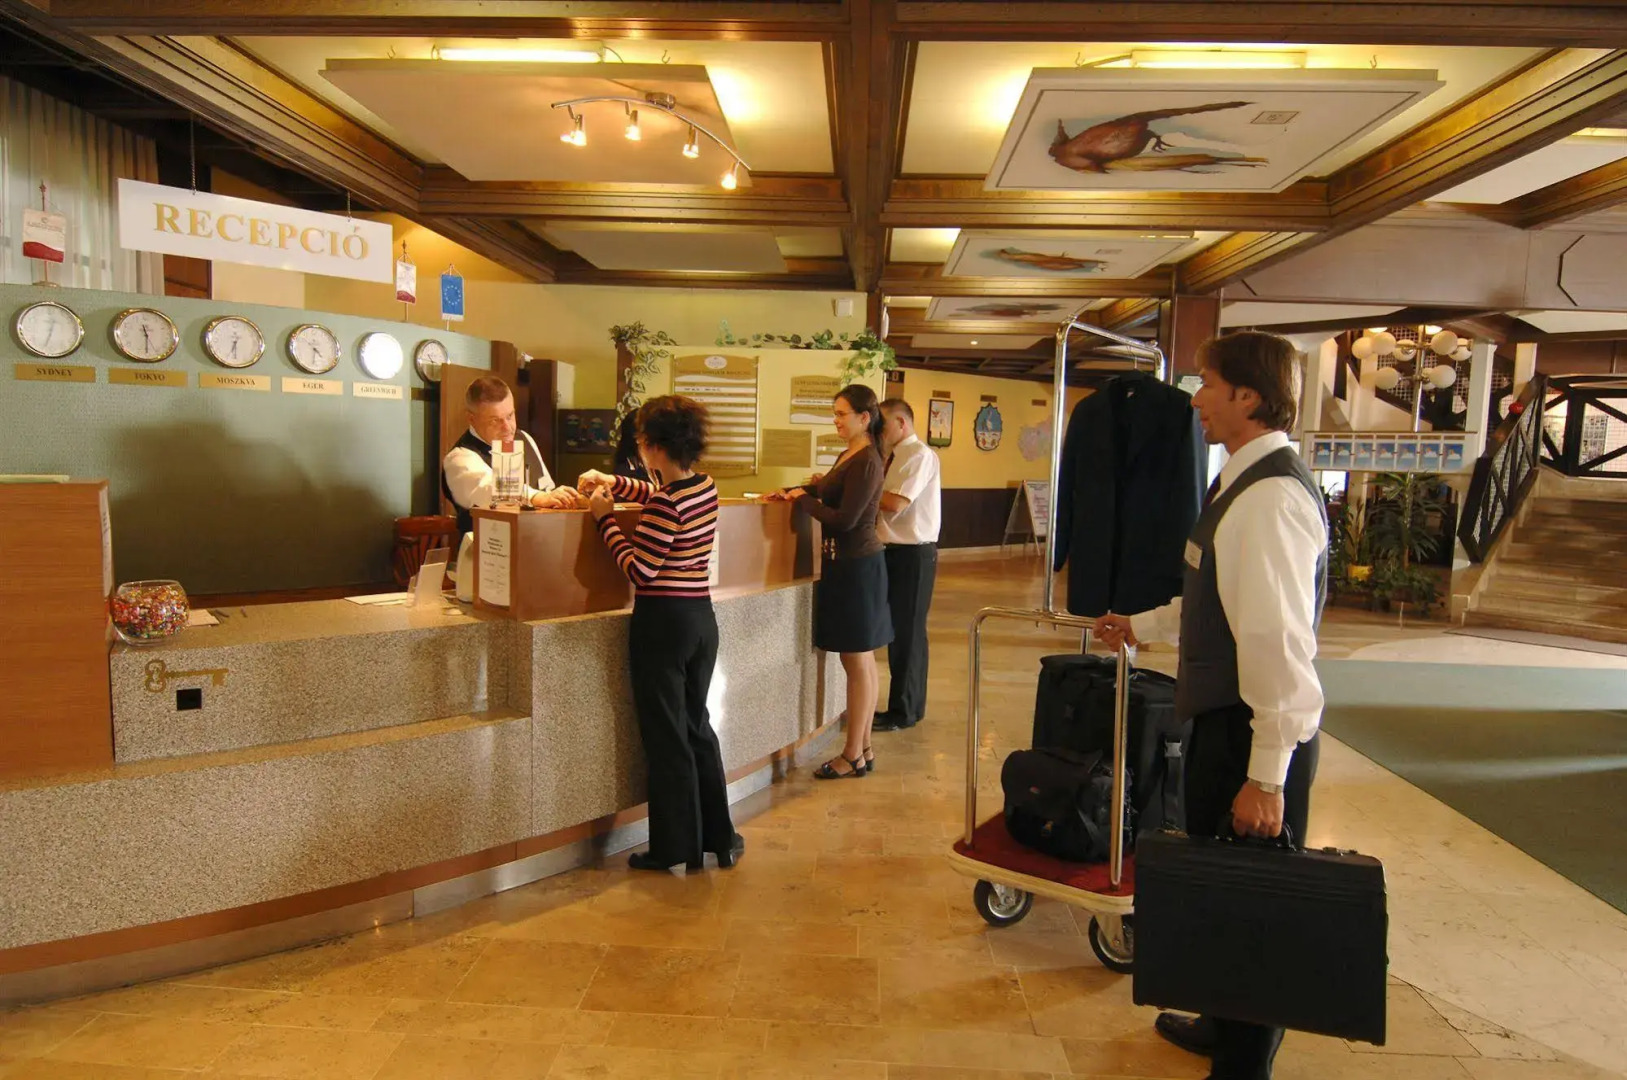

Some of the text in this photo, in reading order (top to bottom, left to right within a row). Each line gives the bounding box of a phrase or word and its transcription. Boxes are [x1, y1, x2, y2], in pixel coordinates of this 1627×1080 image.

[153, 203, 370, 261] RECEPCIÓ
[36, 368, 73, 377] SYDNEY
[134, 372, 165, 382] TOKYO
[216, 376, 256, 386] MOSZKVA
[302, 382, 324, 390] EGER
